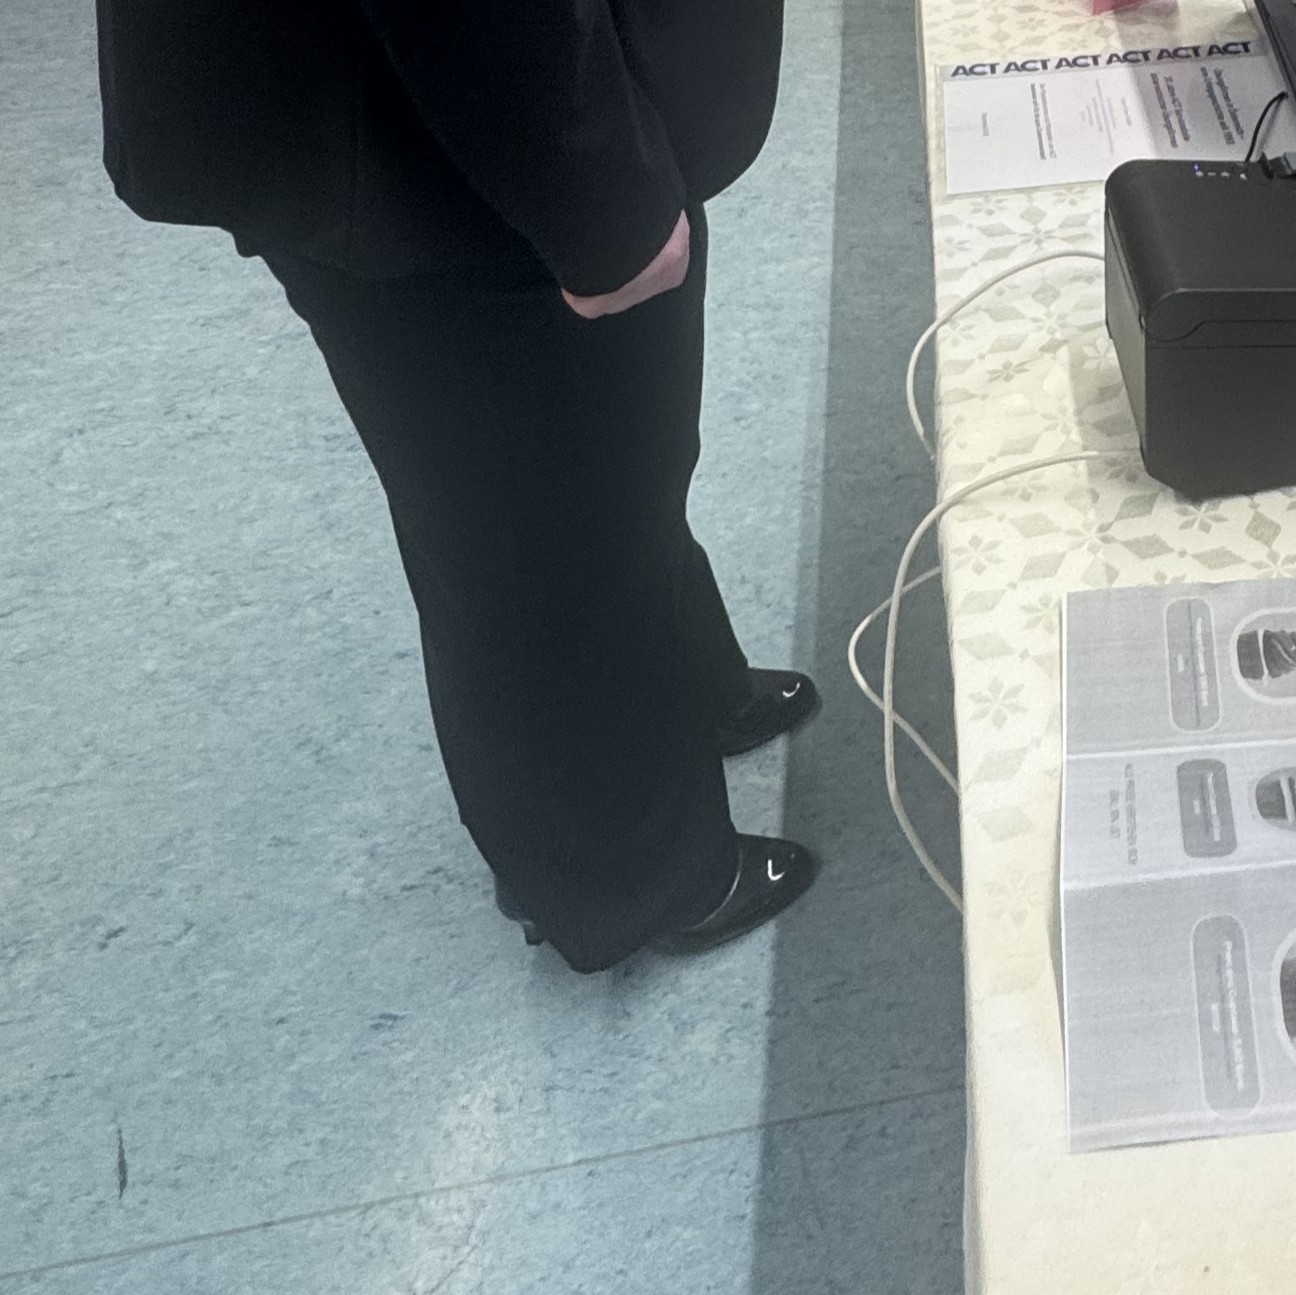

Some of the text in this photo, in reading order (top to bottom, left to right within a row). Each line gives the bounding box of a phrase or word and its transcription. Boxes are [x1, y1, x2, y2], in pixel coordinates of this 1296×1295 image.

[951, 41, 1251, 78] ACT ACT ACT ACT ACT ACT
